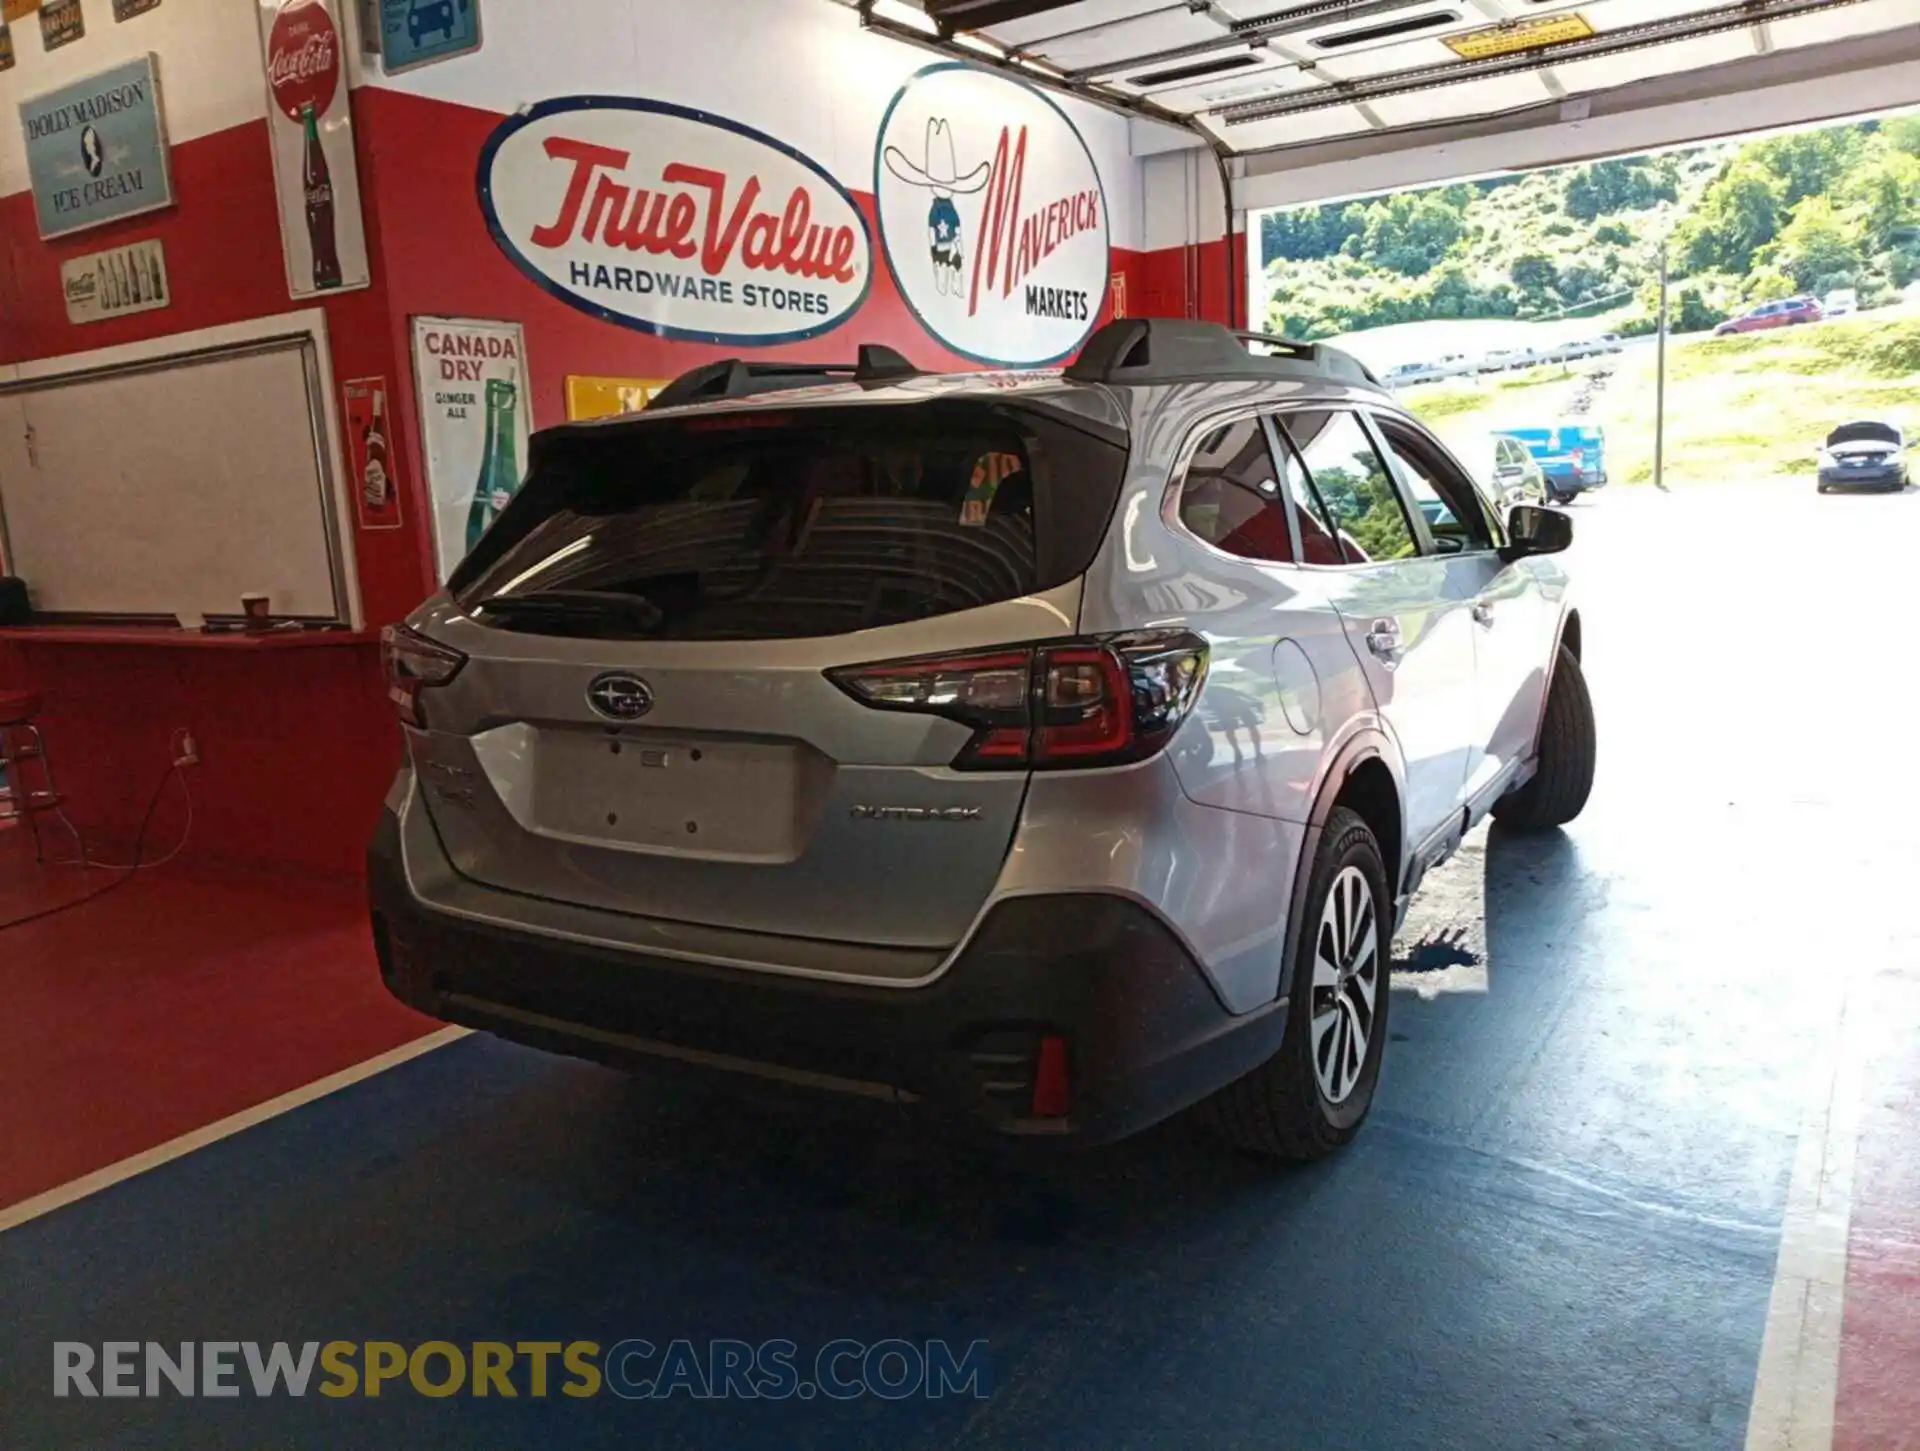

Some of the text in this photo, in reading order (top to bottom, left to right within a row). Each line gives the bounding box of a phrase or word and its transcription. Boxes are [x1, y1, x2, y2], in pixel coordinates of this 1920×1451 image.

[28, 80, 145, 141] DOLLY MADISON
[53, 168, 145, 213] ICE CREAM
[968, 124, 1099, 318] MAVERICK
[569, 260, 830, 316] HARDWARE STORES
[1025, 283, 1089, 322] MARKETS
[425, 332, 517, 359] CANADA
[440, 359, 484, 382] DRY
[435, 392, 476, 405] GINGER
[446, 407, 467, 419] ALE
[850, 803, 983, 821] OUTBACK
